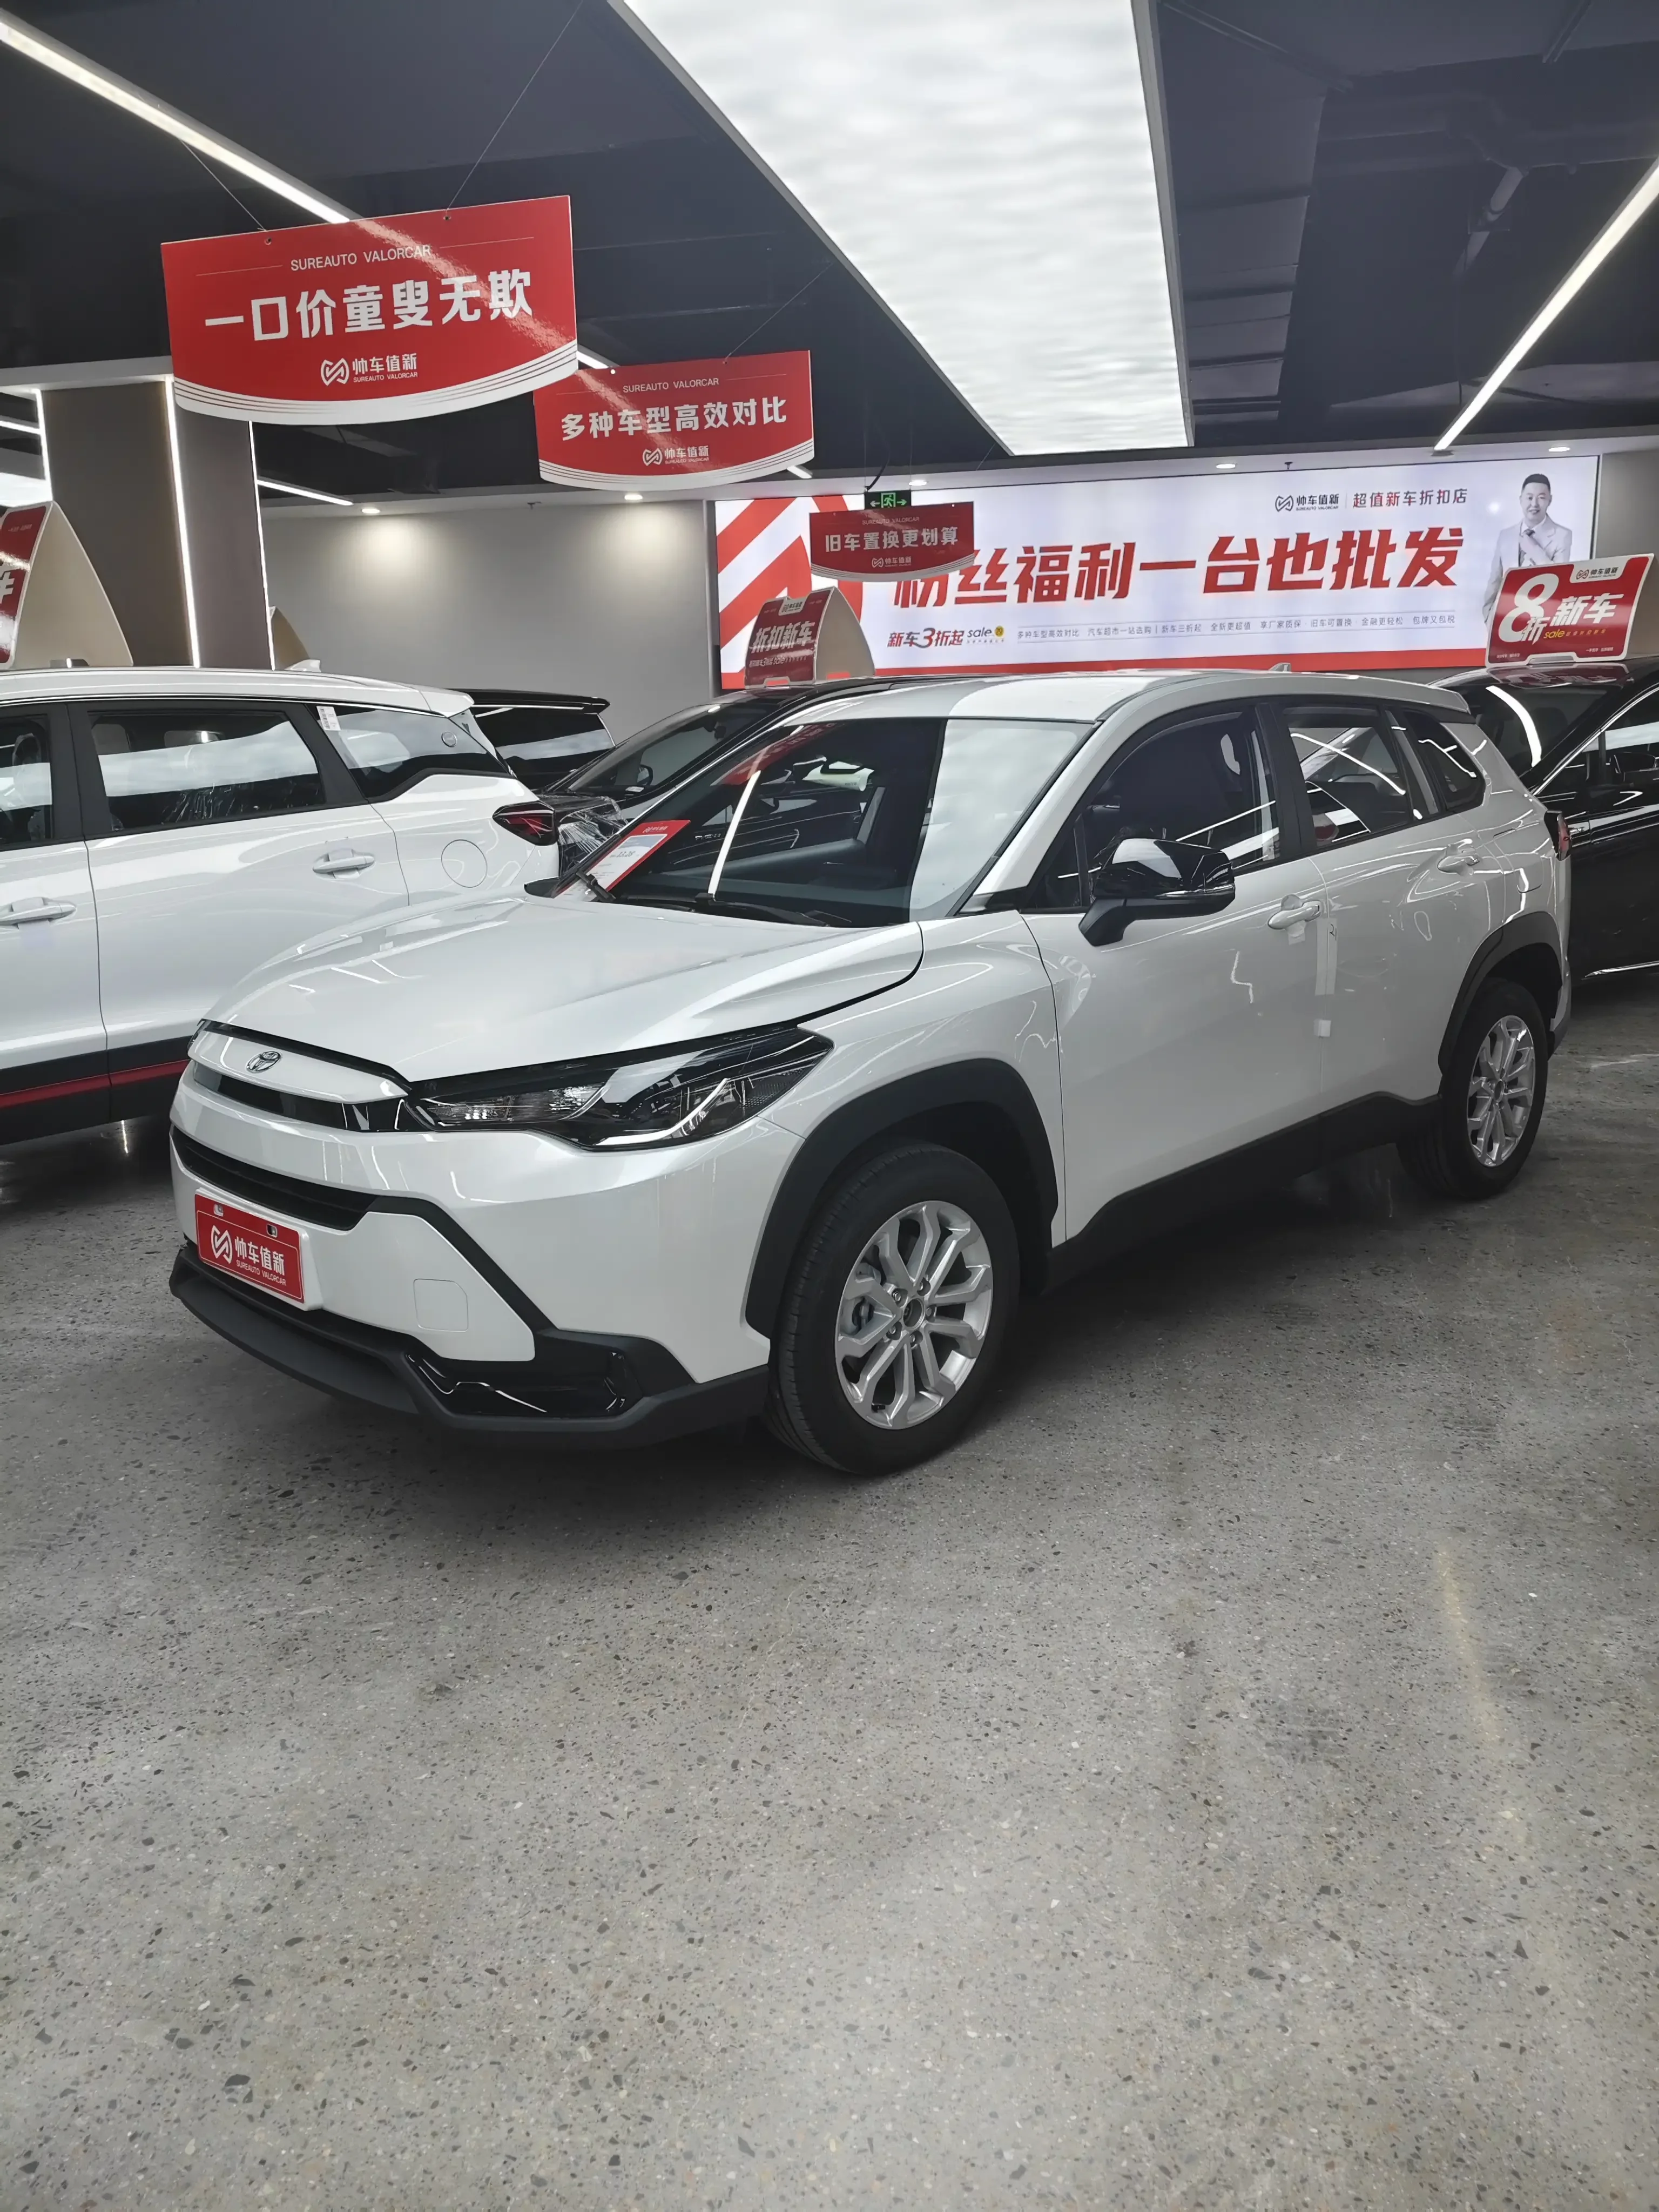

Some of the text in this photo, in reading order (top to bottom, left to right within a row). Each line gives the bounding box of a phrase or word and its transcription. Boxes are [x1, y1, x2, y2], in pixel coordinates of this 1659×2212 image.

[291, 245, 431, 271] SUREAUTO VALORCAR
[205, 268, 533, 341] 一口价童叟无欺
[353, 353, 417, 374] 帅车值新
[353, 372, 418, 383] SUREAUTO VALORCAR
[623, 377, 719, 393] SUREAUTO VALORCAR
[562, 396, 787, 441] 多种车型高效对比
[664, 445, 709, 459] 帅车值新
[1296, 494, 1339, 506] 帅车值新
[1352, 488, 1468, 508] 超值新车折扣店
[825, 526, 958, 552] 旧车置换更划算
[751, 621, 815, 653] 折扣新车
[887, 628, 965, 649] 新车3折起
[967, 626, 992, 638] sale
[1543, 629, 1565, 639] sale
[234, 1236, 285, 1276] 帅车值新
[236, 1260, 286, 1286] SUREAUTO VALORCAR
